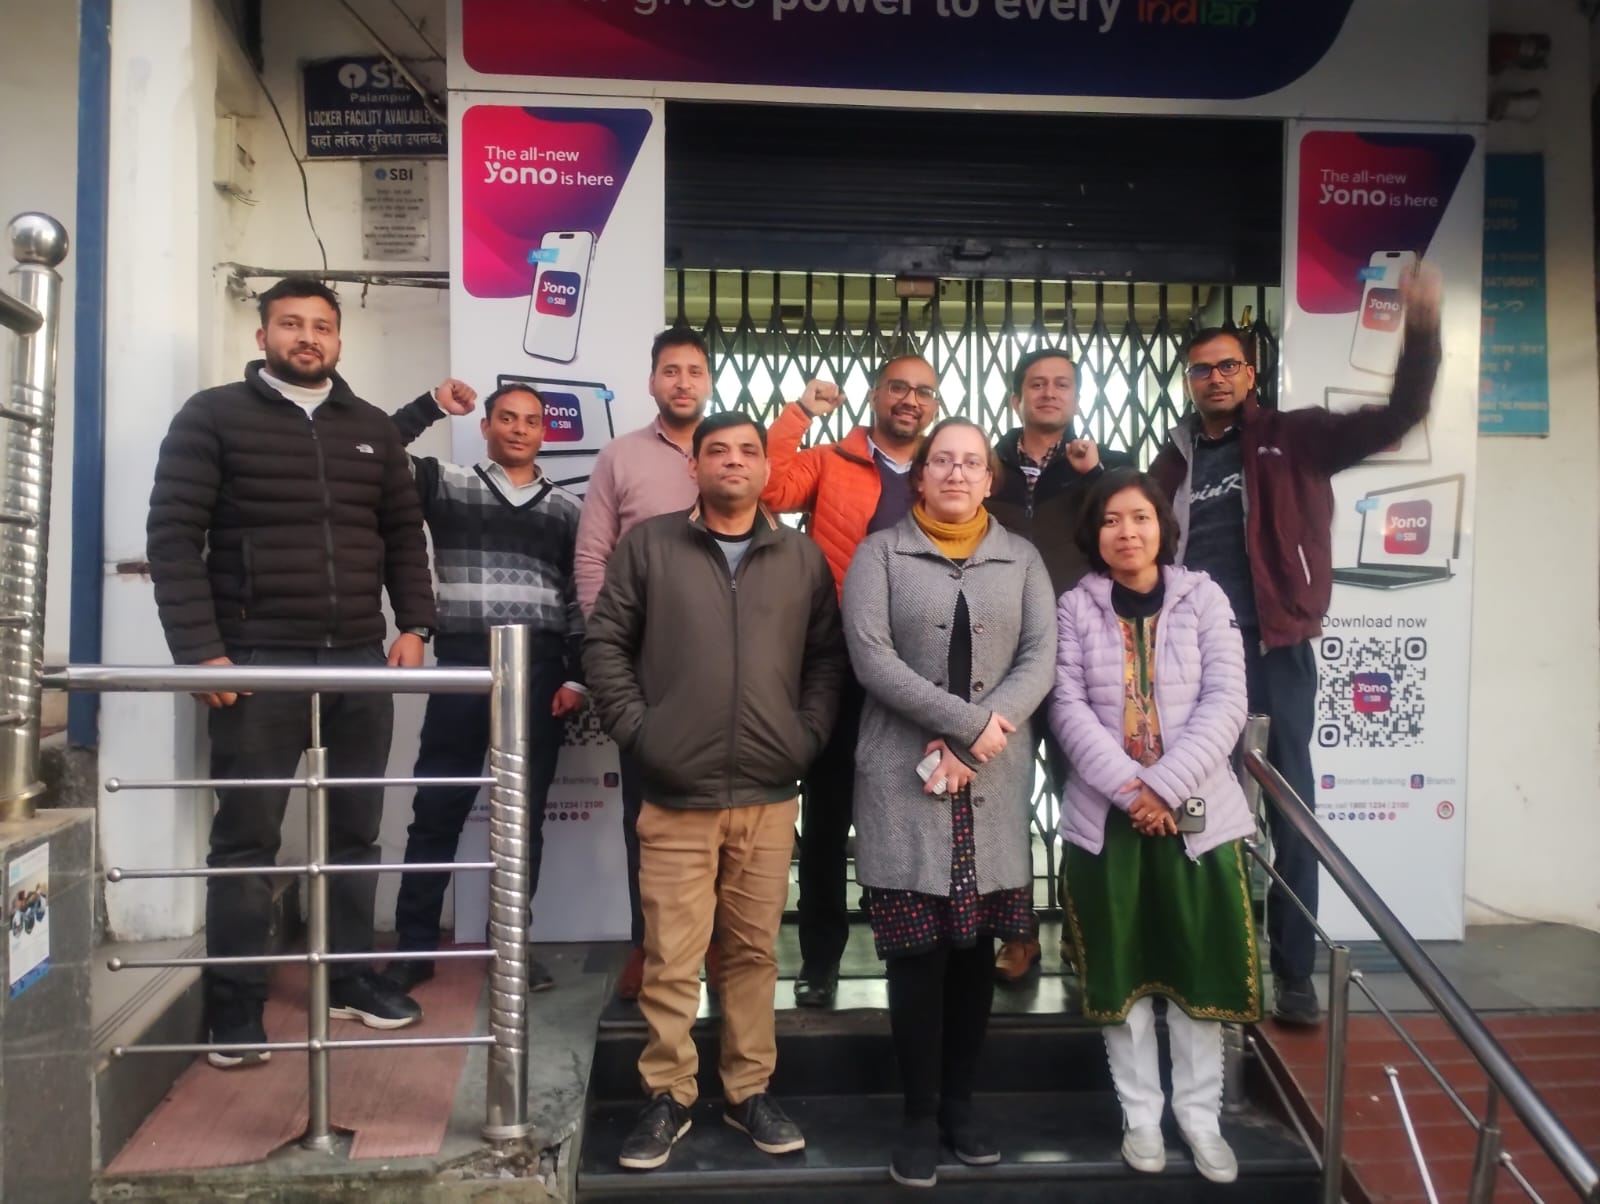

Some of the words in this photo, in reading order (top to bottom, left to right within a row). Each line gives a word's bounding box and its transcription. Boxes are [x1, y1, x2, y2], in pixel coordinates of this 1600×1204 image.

[995, 0, 1121, 32] every
[350, 93, 411, 104] Palampur
[309, 111, 342, 126] LOCKER
[344, 110, 383, 126] FACILITY
[384, 109, 431, 125] AVAILABLE
[484, 145, 517, 160] The
[520, 147, 580, 162] all-new
[390, 167, 413, 181] SBI
[561, 171, 574, 185] is
[577, 172, 615, 187] here
[1320, 169, 1350, 183] The
[1353, 169, 1408, 185] all-new
[1389, 193, 1402, 207] is
[1404, 194, 1440, 207] here
[1321, 614, 1393, 628] Download
[1397, 617, 1428, 628] now
[1372, 777, 1407, 787] Banking
[1369, 801, 1386, 809] 1234
